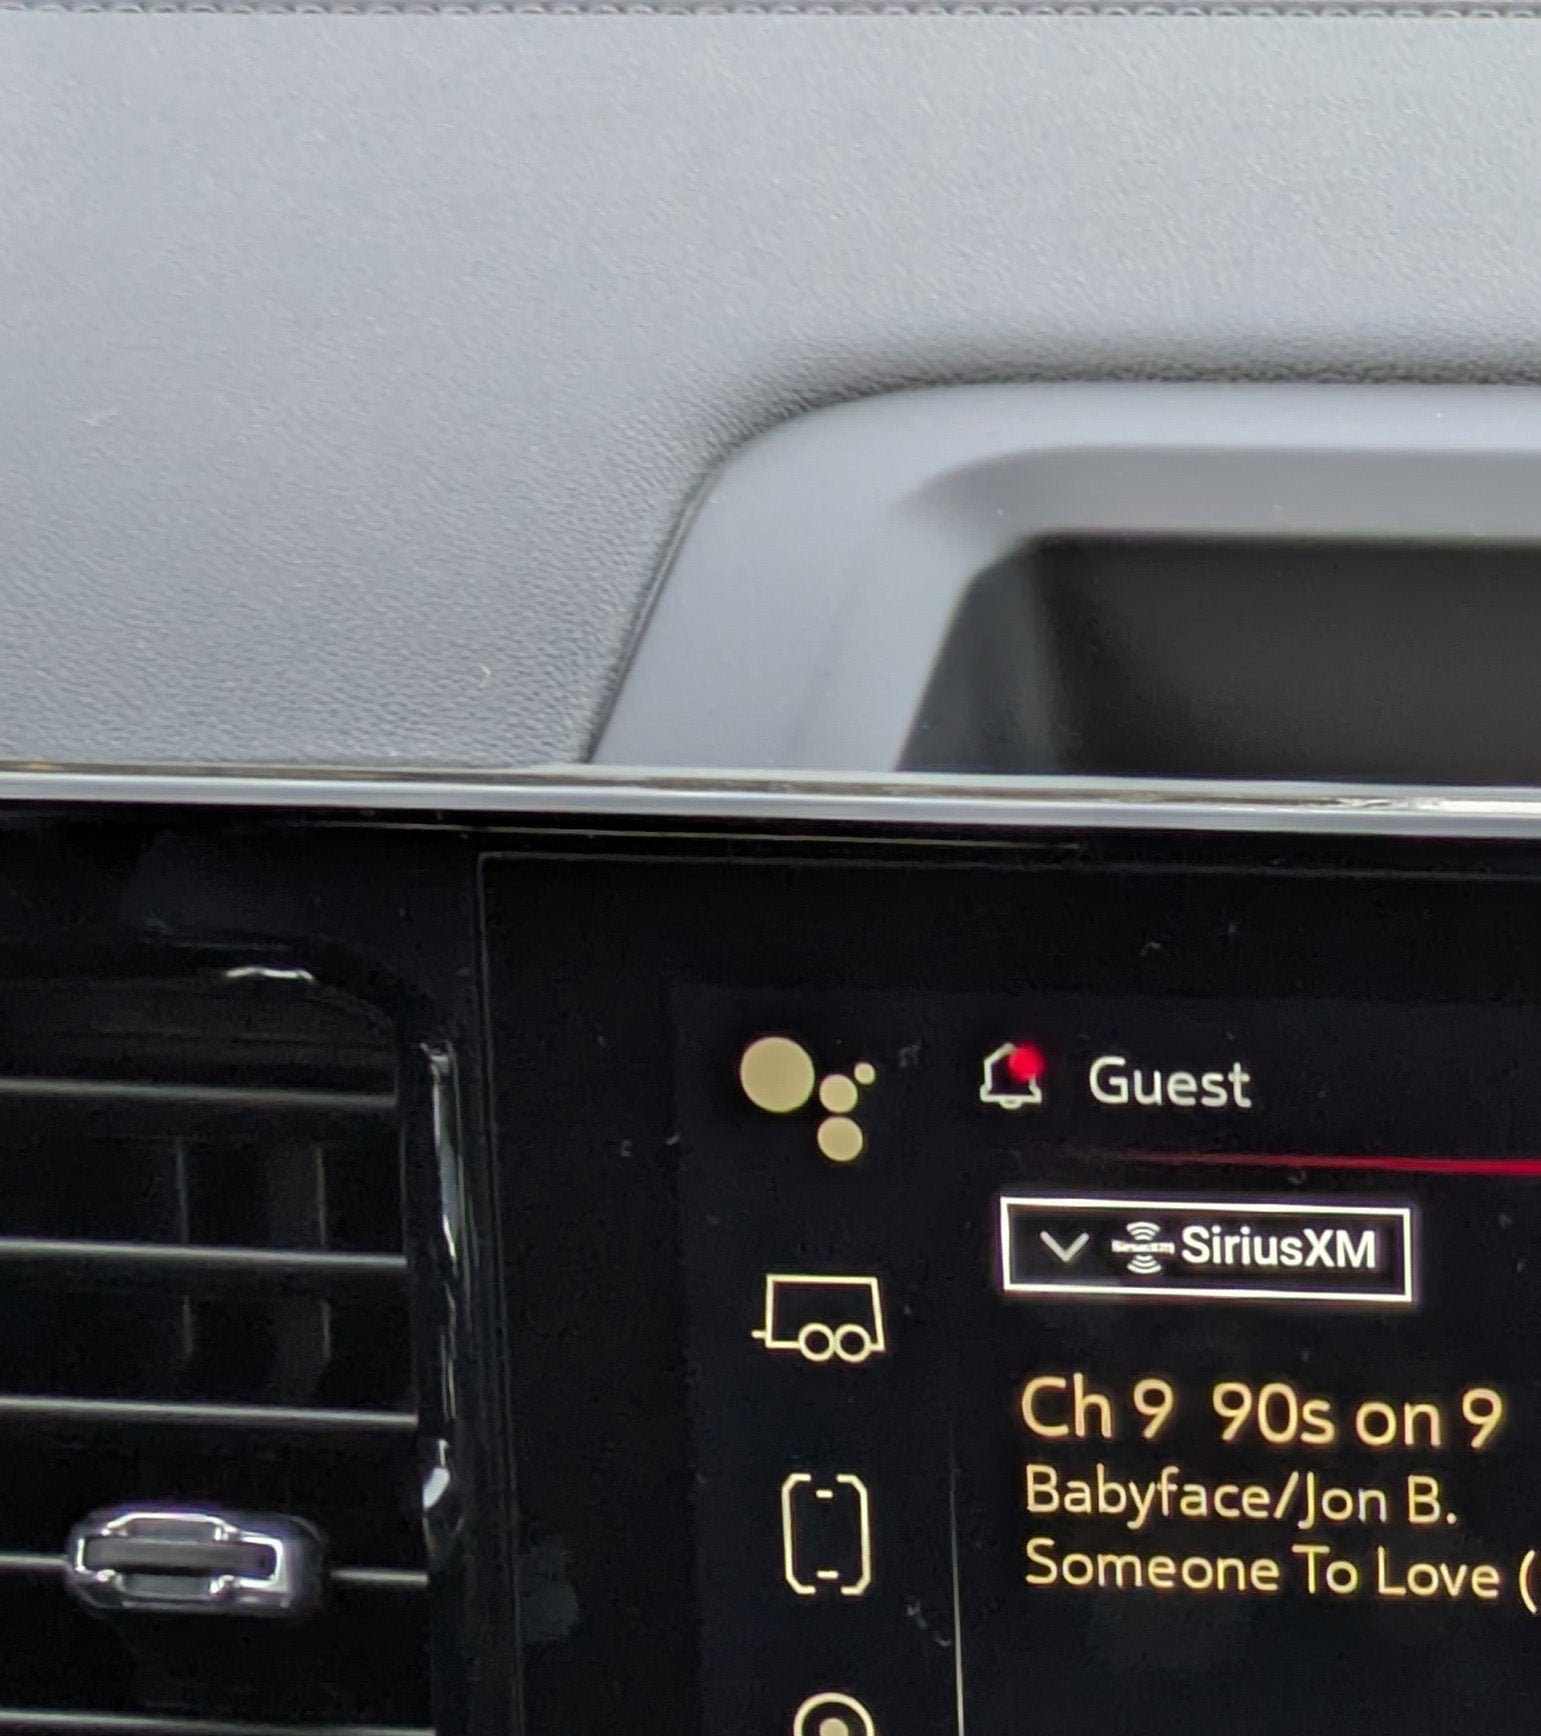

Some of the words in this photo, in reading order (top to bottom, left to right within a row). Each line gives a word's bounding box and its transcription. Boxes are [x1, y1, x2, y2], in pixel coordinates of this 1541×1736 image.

[1089, 1056, 1252, 1108] Guest
[1181, 1224, 1376, 1269] SiriusXM
[1021, 1372, 1113, 1439] Ch
[1133, 1379, 1174, 1439] 9
[1212, 1382, 1336, 1445] 90s
[1356, 1402, 1441, 1447] on
[1462, 1387, 1503, 1449] 9
[1026, 1462, 1388, 1530] Babyface/Jon
[1407, 1474, 1458, 1525] B.
[1025, 1537, 1280, 1591] Someone
[1291, 1544, 1358, 1594] To
[1377, 1546, 1501, 1599] Love
